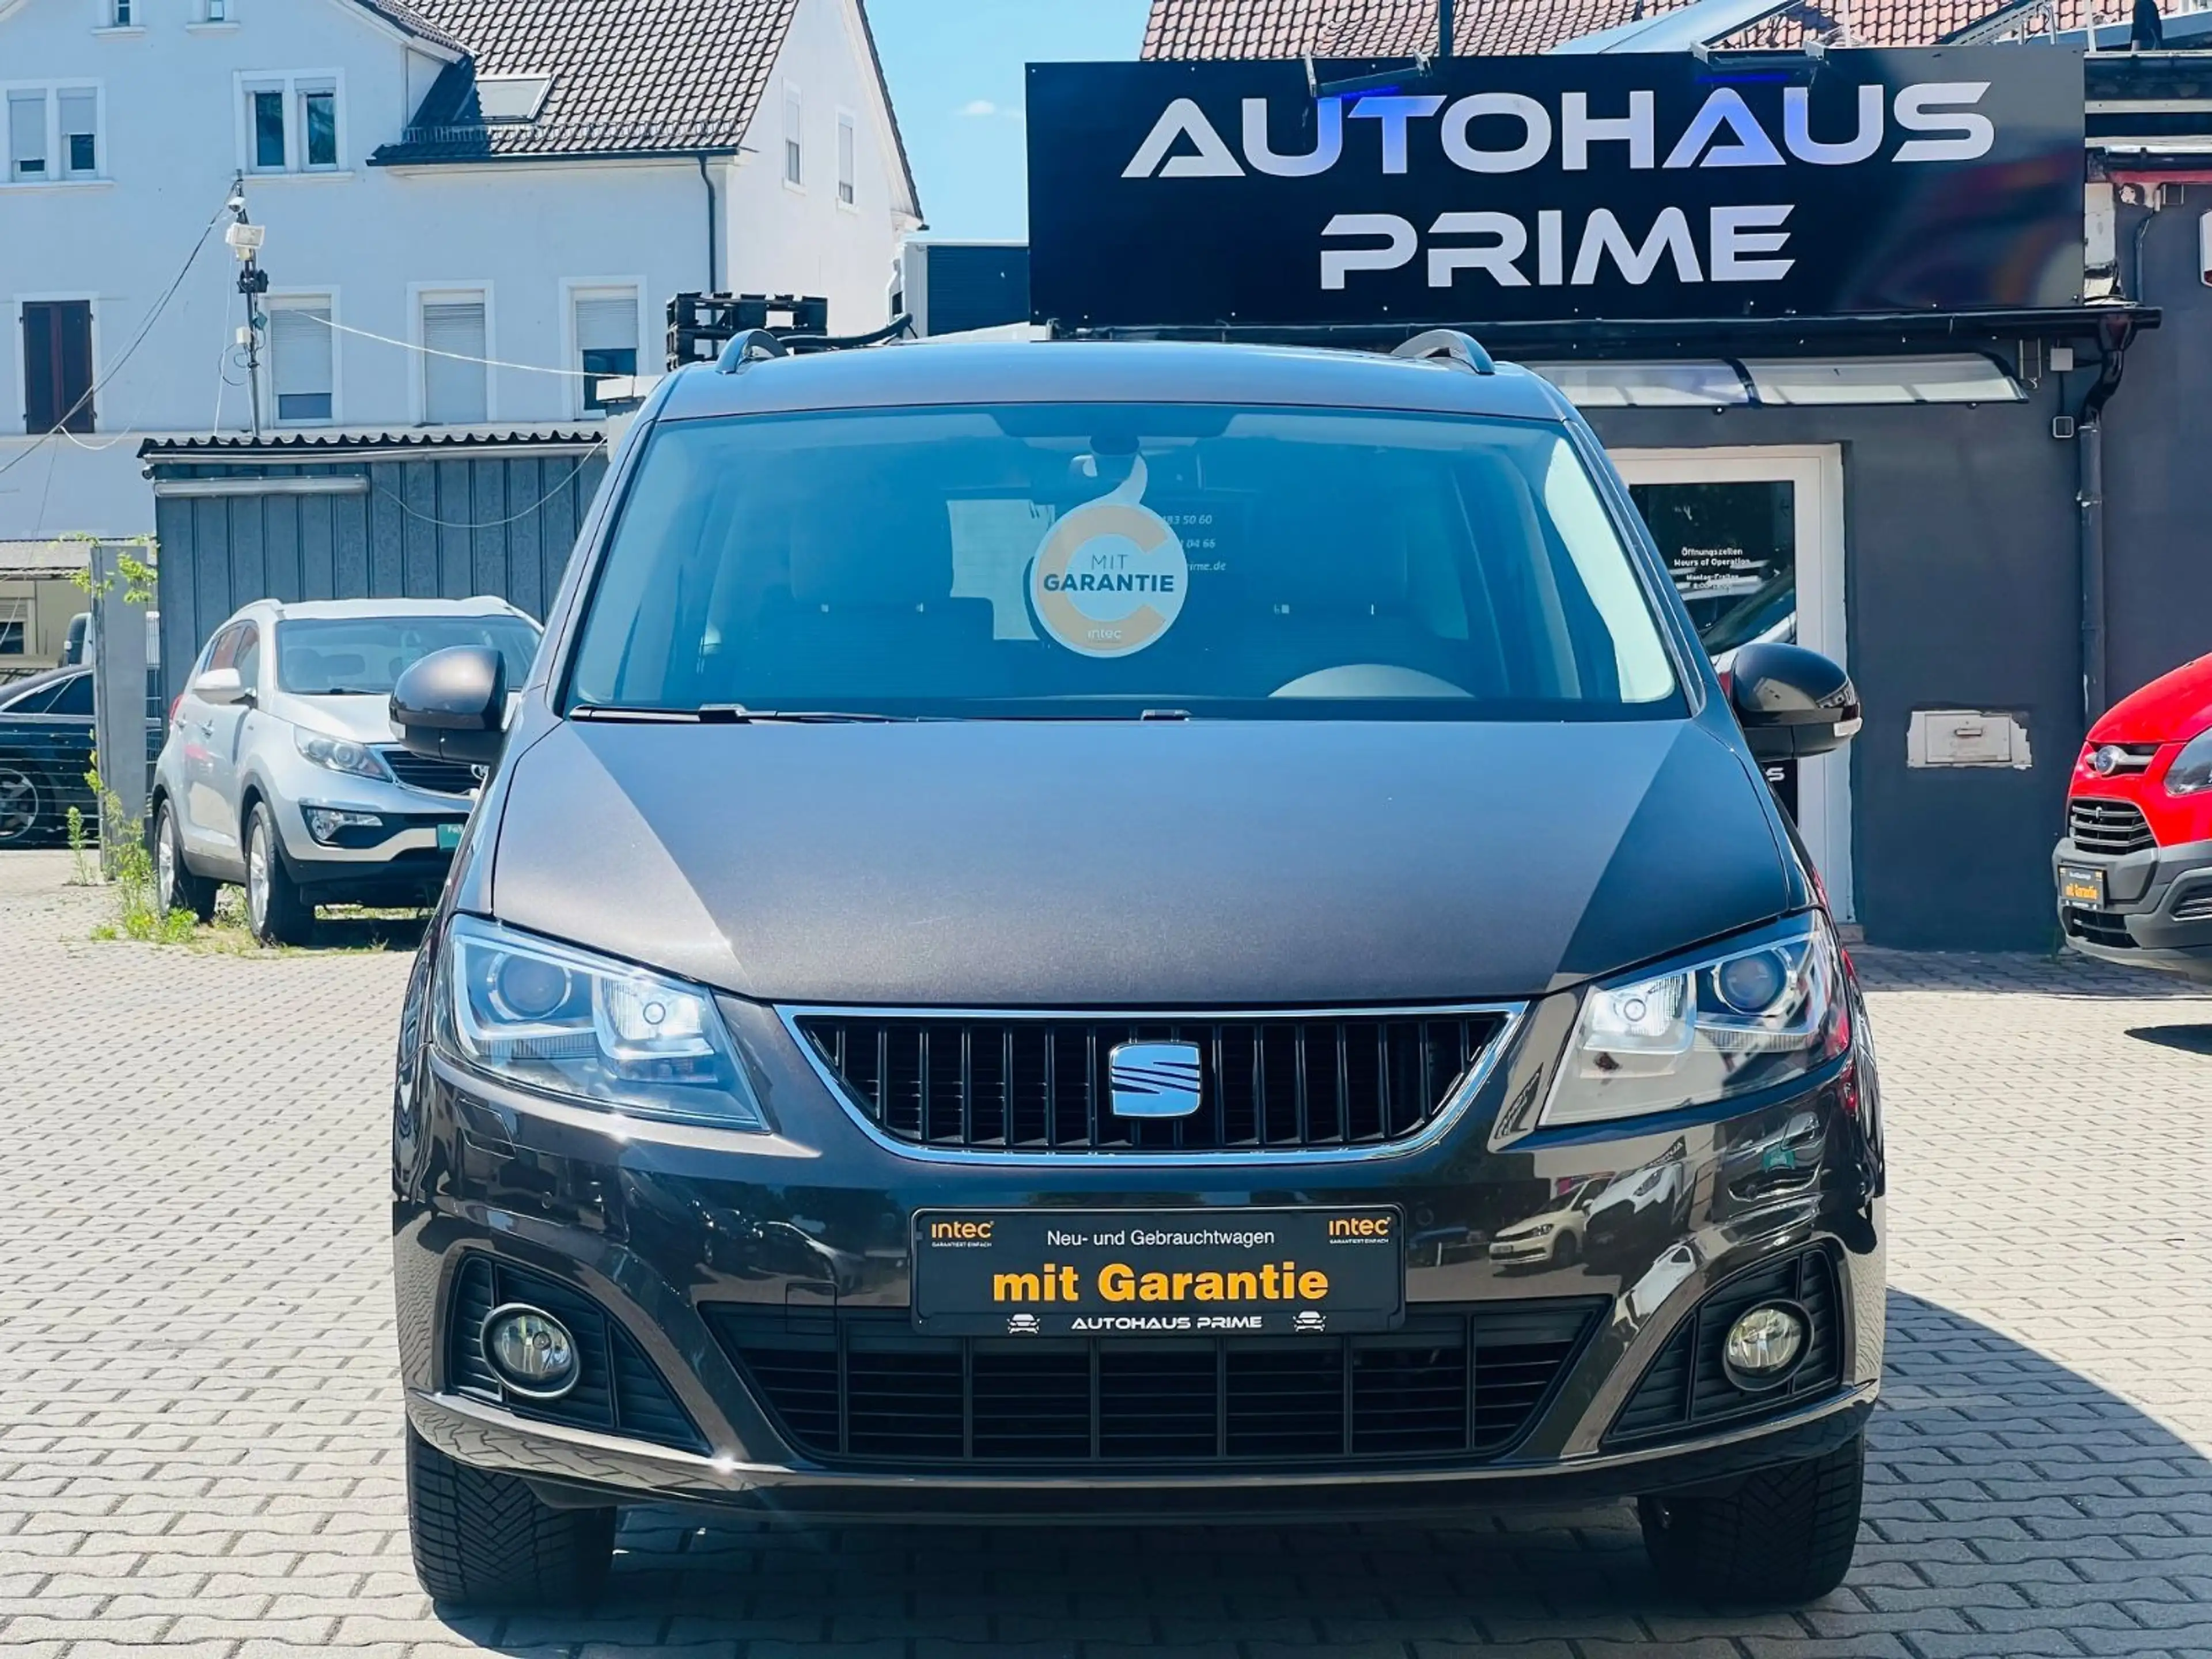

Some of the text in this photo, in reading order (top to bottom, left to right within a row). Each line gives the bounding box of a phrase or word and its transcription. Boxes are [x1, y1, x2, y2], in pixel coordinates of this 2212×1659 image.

[1121, 81, 1995, 179] AUTOHAUS
[1320, 204, 1796, 290] PRIME
[1091, 554, 1128, 571] MIT
[1043, 573, 1175, 593] GARANTIE
[931, 1221, 992, 1238] intec
[1328, 1218, 1389, 1236] intec
[1047, 1228, 1275, 1249] Neu- und Gebrauchtwagen
[993, 1261, 1328, 1302] mit Garantie
[1071, 1316, 1263, 1330] AUTOHAUS PRIME
